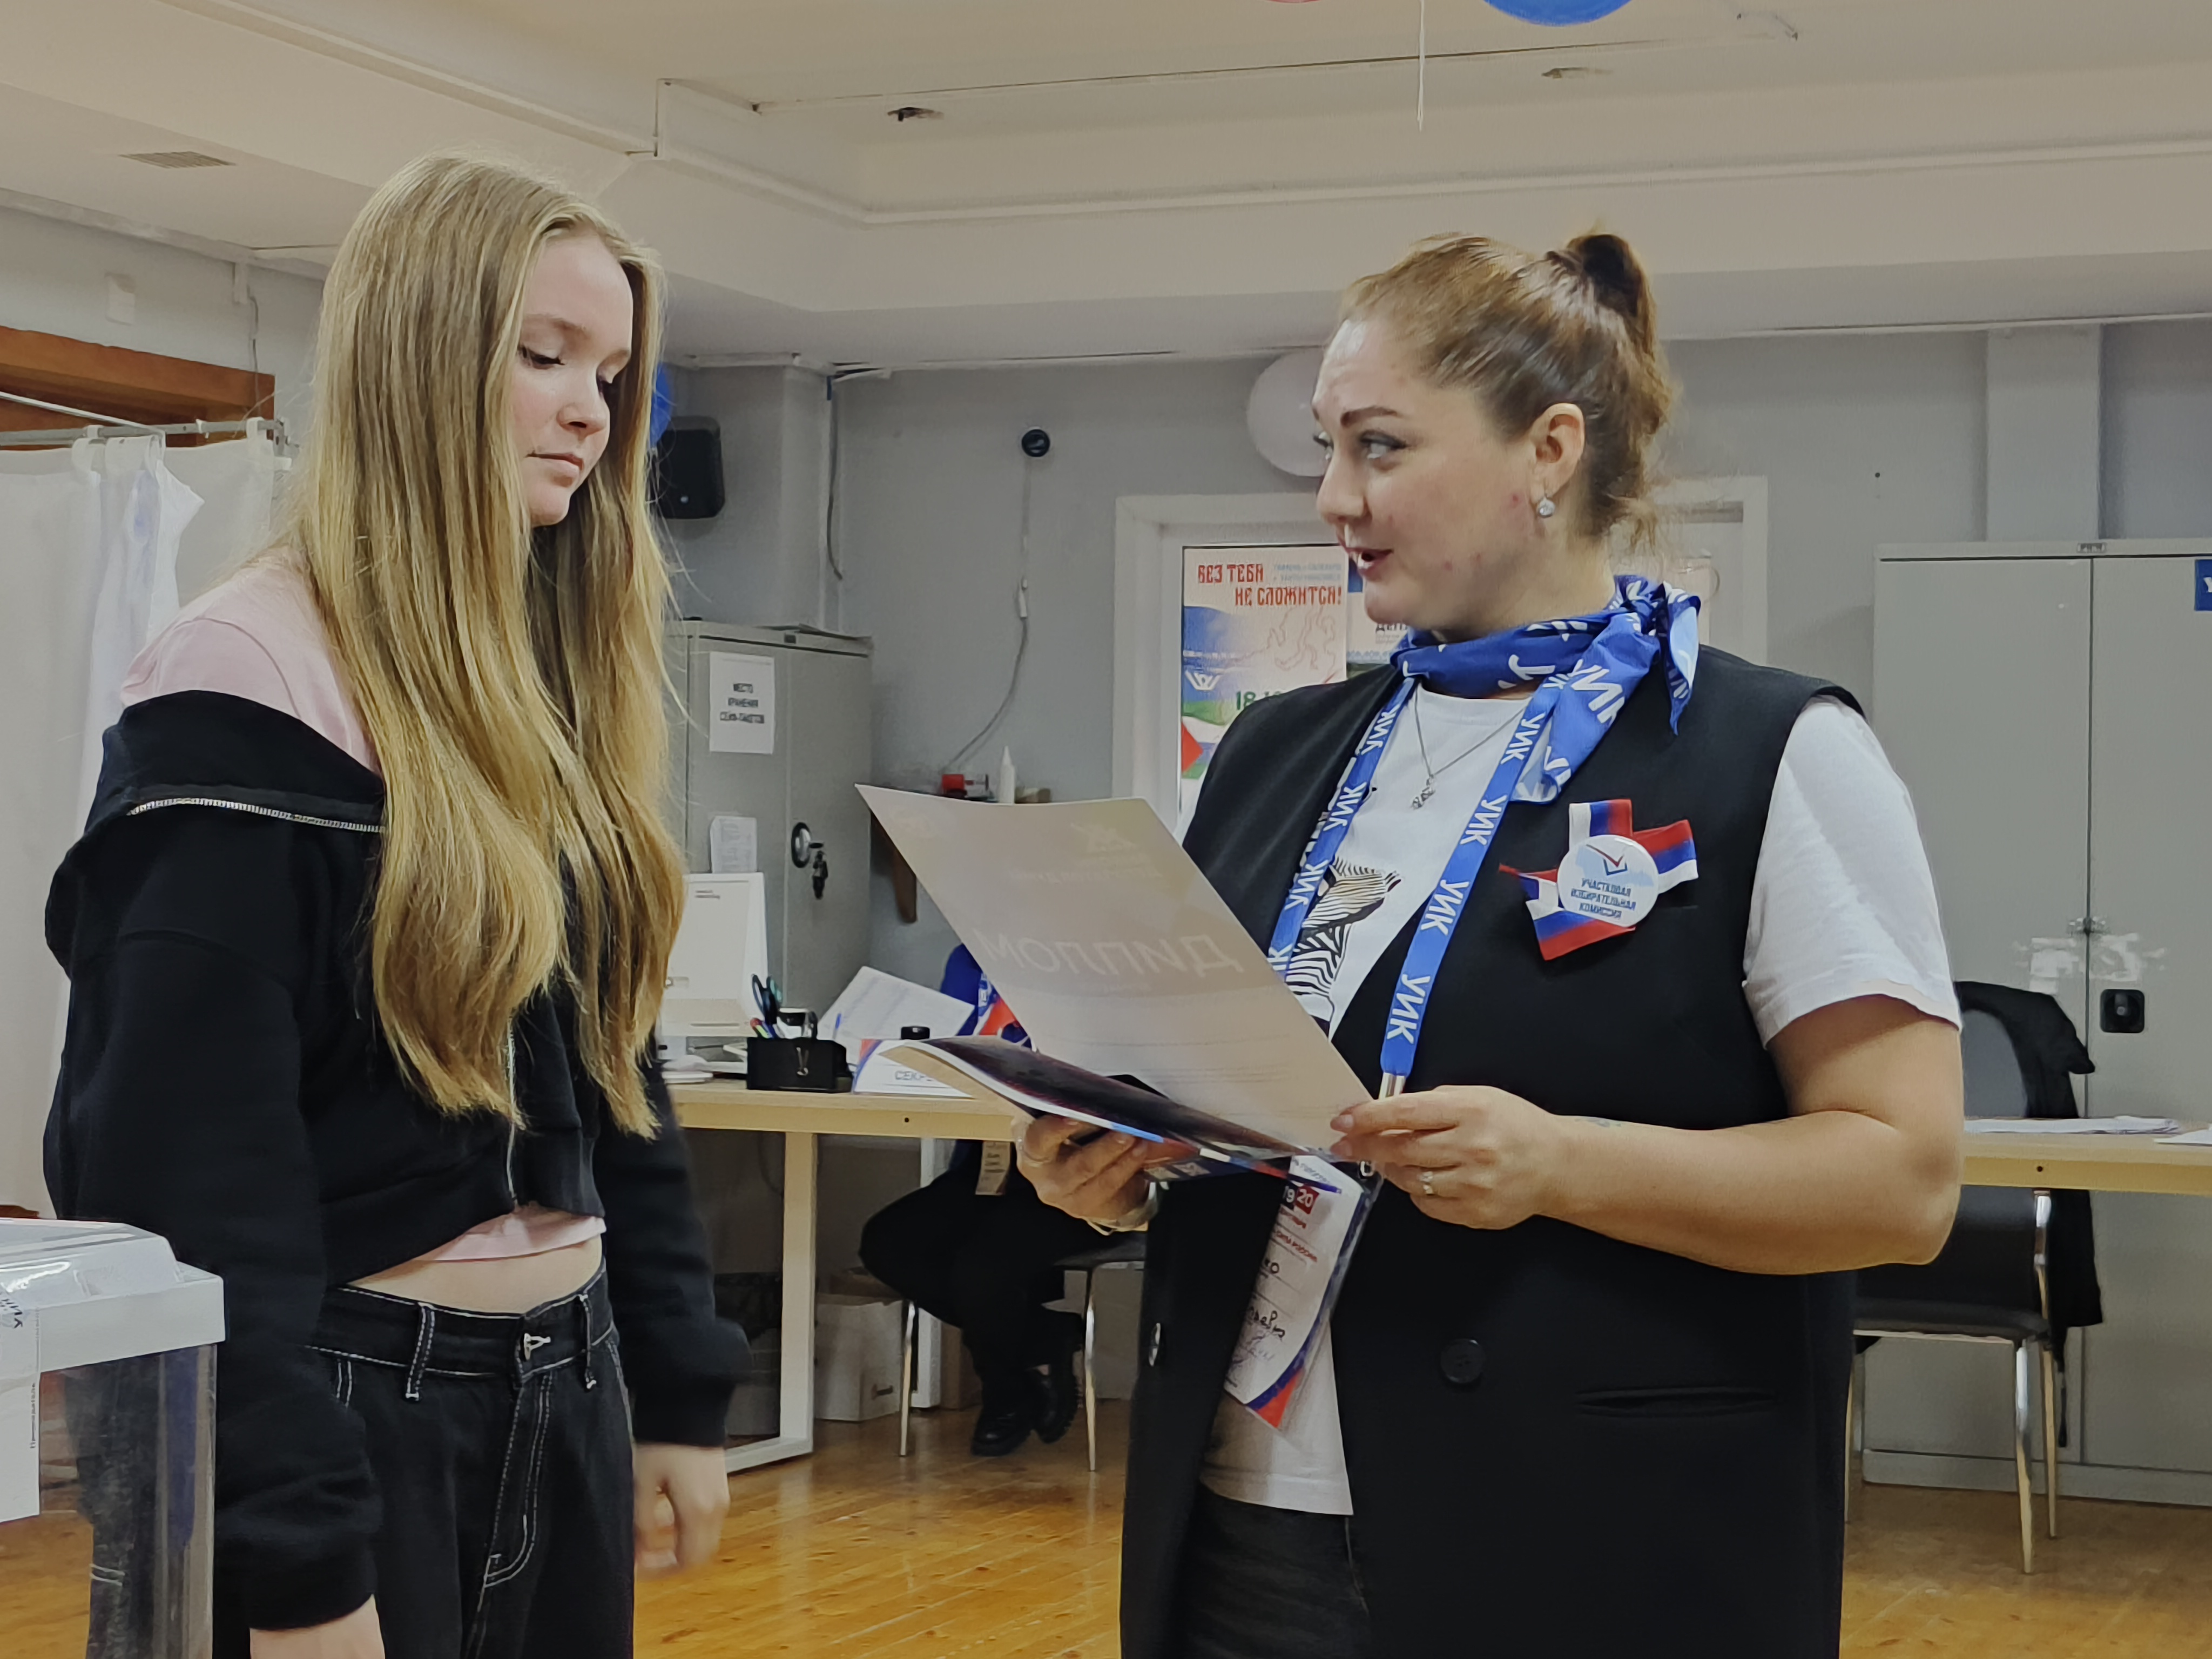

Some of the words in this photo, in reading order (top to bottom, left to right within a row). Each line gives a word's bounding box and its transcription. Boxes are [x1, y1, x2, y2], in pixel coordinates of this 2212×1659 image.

[1198, 564, 1223, 583] БЕЗ
[1226, 563, 1264, 583] ТЕБЯ
[1235, 586, 1252, 606] НЕ
[1257, 585, 1342, 606] СЛОЖИТСЯ!
[1360, 703, 1401, 756] УИК
[1501, 712, 1546, 765] УИК
[1323, 781, 1367, 832] УИК
[1460, 794, 1508, 846] УИК
[1284, 859, 1330, 911] УИК
[1420, 879, 1469, 936] УИК
[1386, 974, 1431, 1044] УИК
[1297, 1188, 1314, 1208] 20
